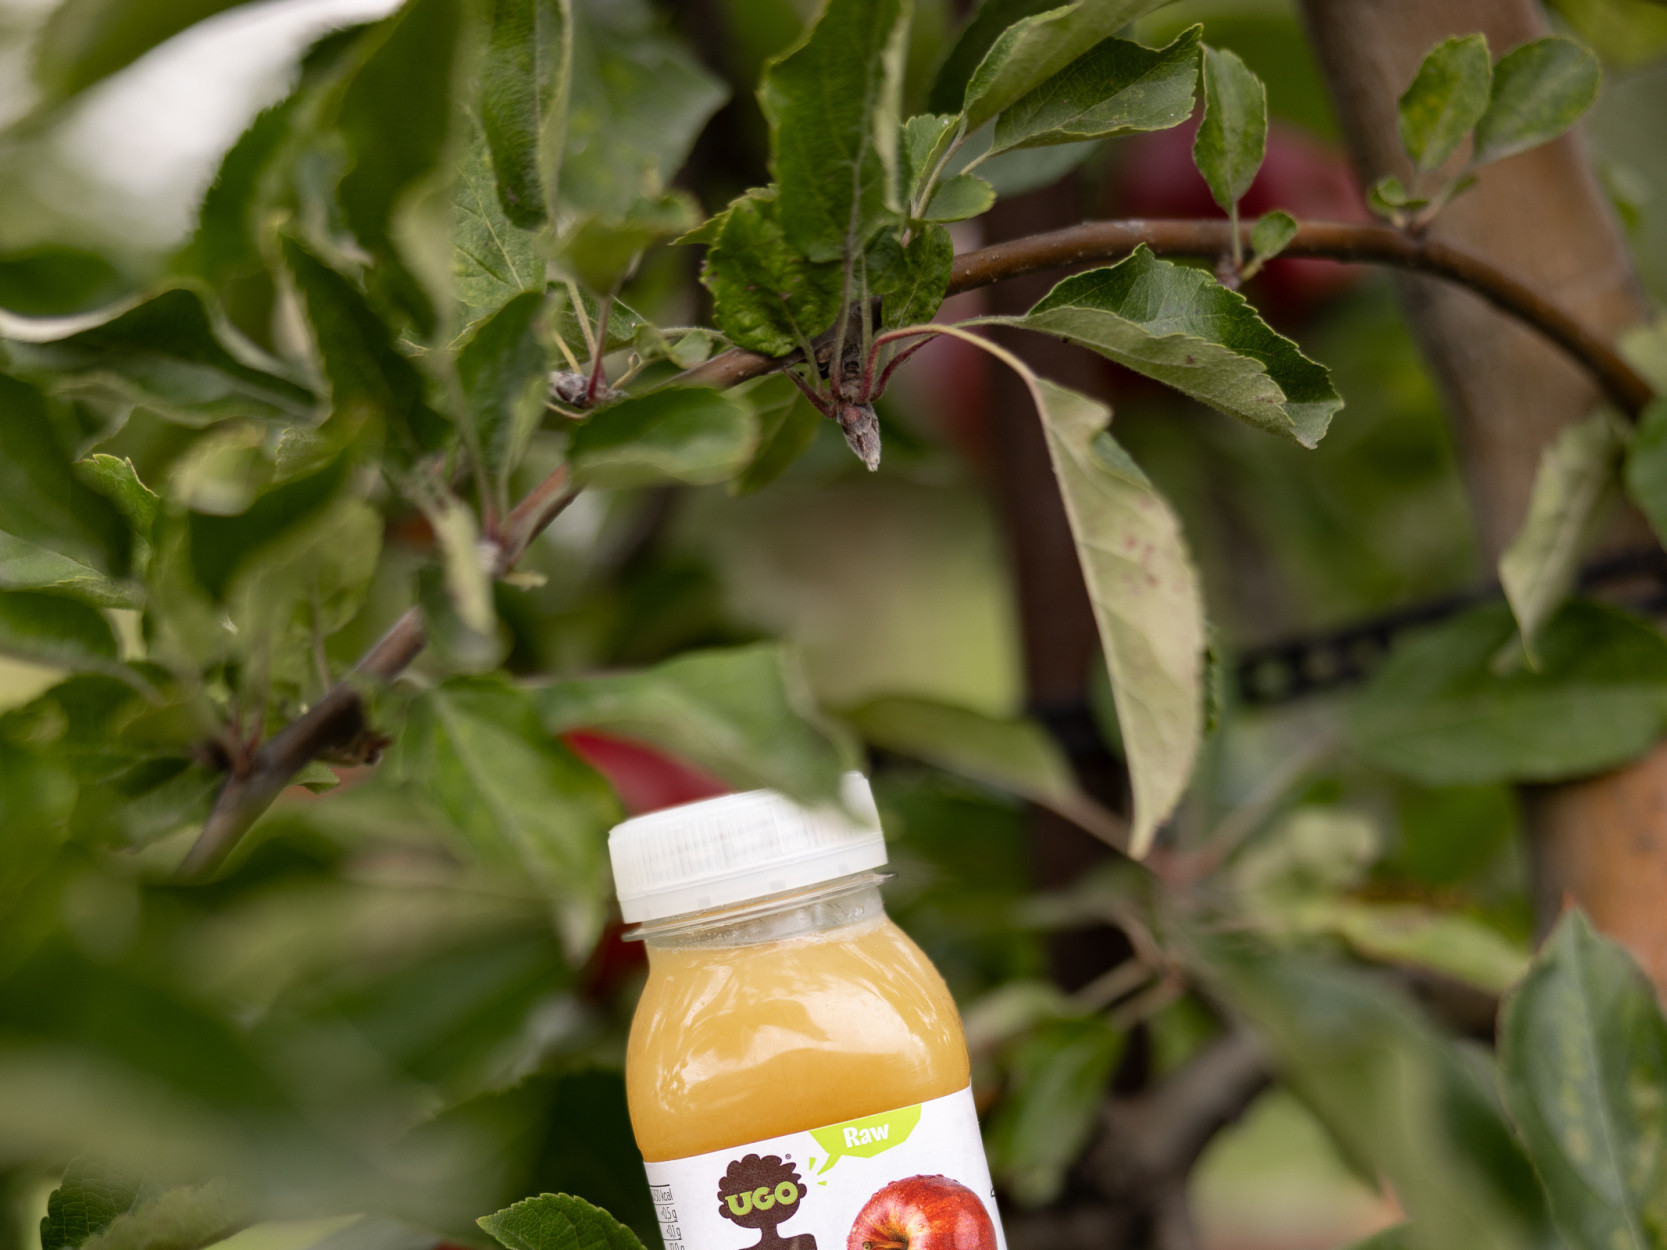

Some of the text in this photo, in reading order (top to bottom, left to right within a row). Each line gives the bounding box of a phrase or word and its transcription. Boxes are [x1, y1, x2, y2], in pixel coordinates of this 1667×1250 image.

[843, 1124, 889, 1148] Raw
[725, 1181, 799, 1216] UGO
[672, 1209, 678, 1222] g
[676, 1227, 682, 1240] g
